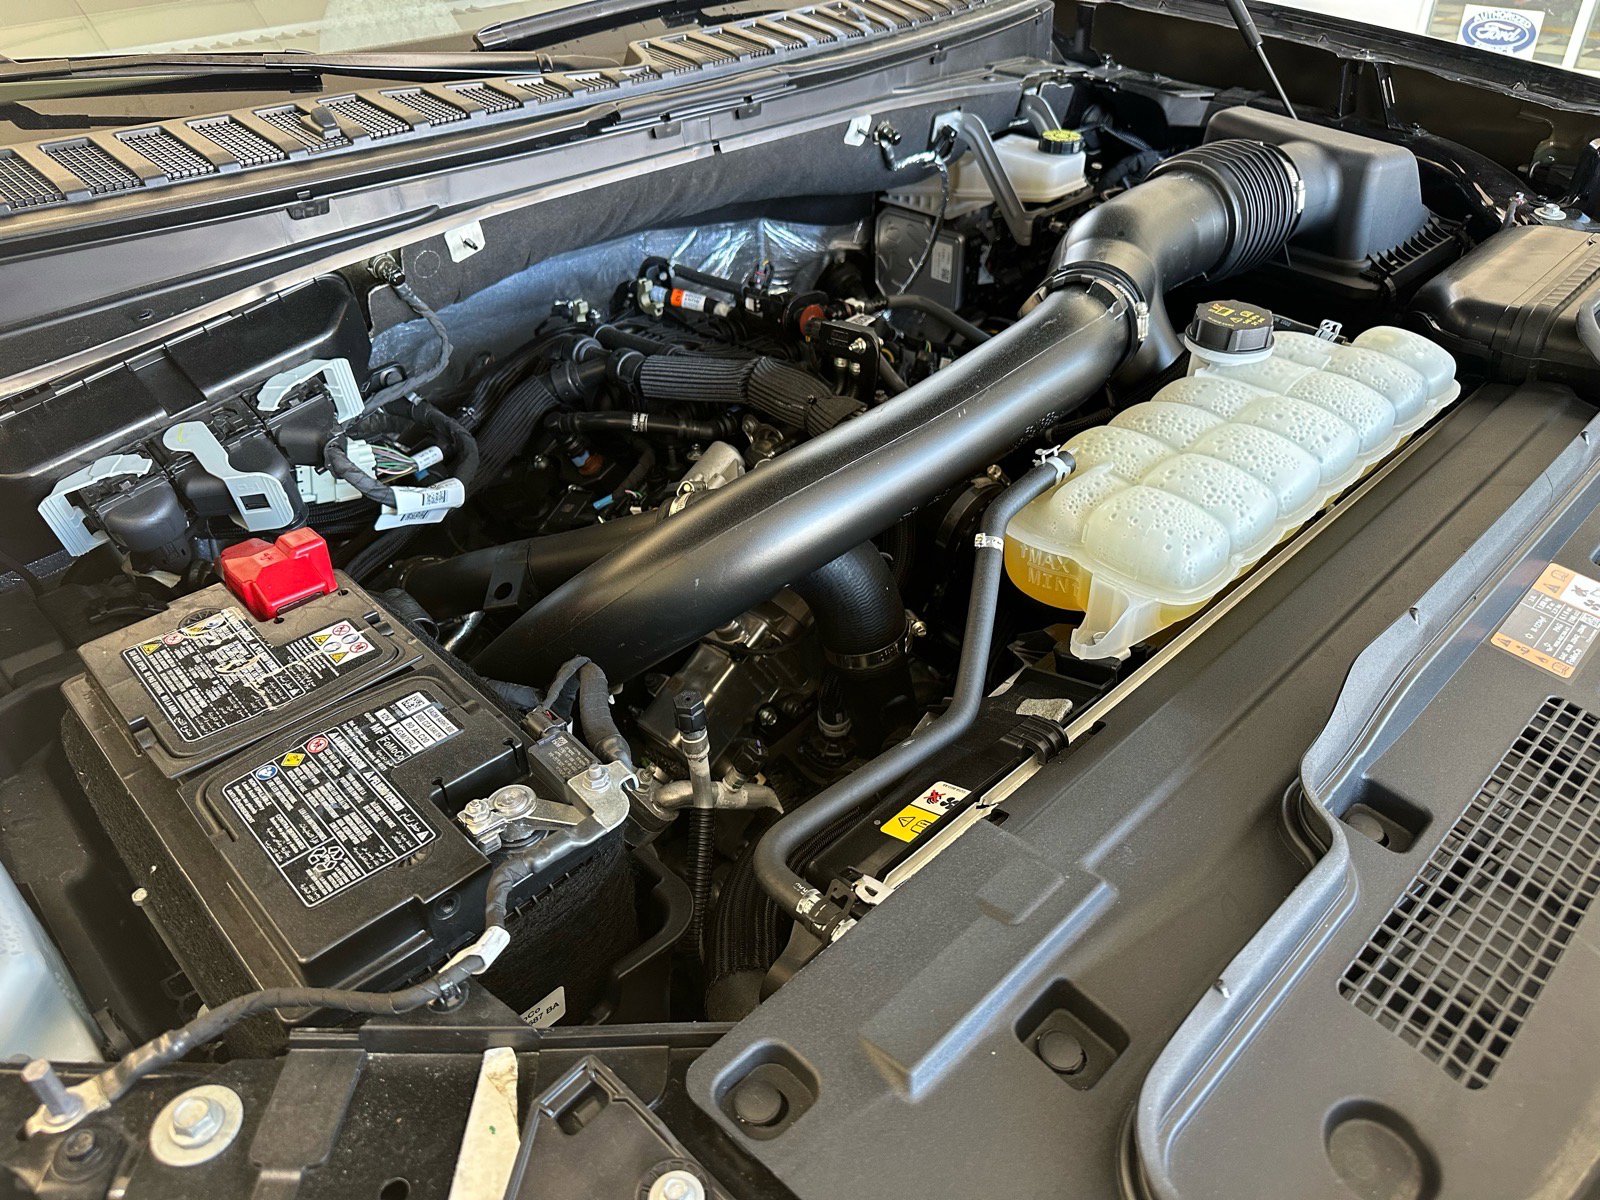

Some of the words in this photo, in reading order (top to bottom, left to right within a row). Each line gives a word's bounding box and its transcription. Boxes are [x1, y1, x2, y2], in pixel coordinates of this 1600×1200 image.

[1475, 22, 1522, 42] Ford
[1029, 547, 1070, 573] MAX
[1028, 568, 1069, 593] MIN
[378, 712, 392, 722] 12V
[368, 722, 387, 736] MF
[391, 726, 419, 751] AGM/VRLA
[410, 727, 422, 735] Ah
[378, 735, 407, 762] FoMoCo
[546, 1002, 560, 1015] BA
